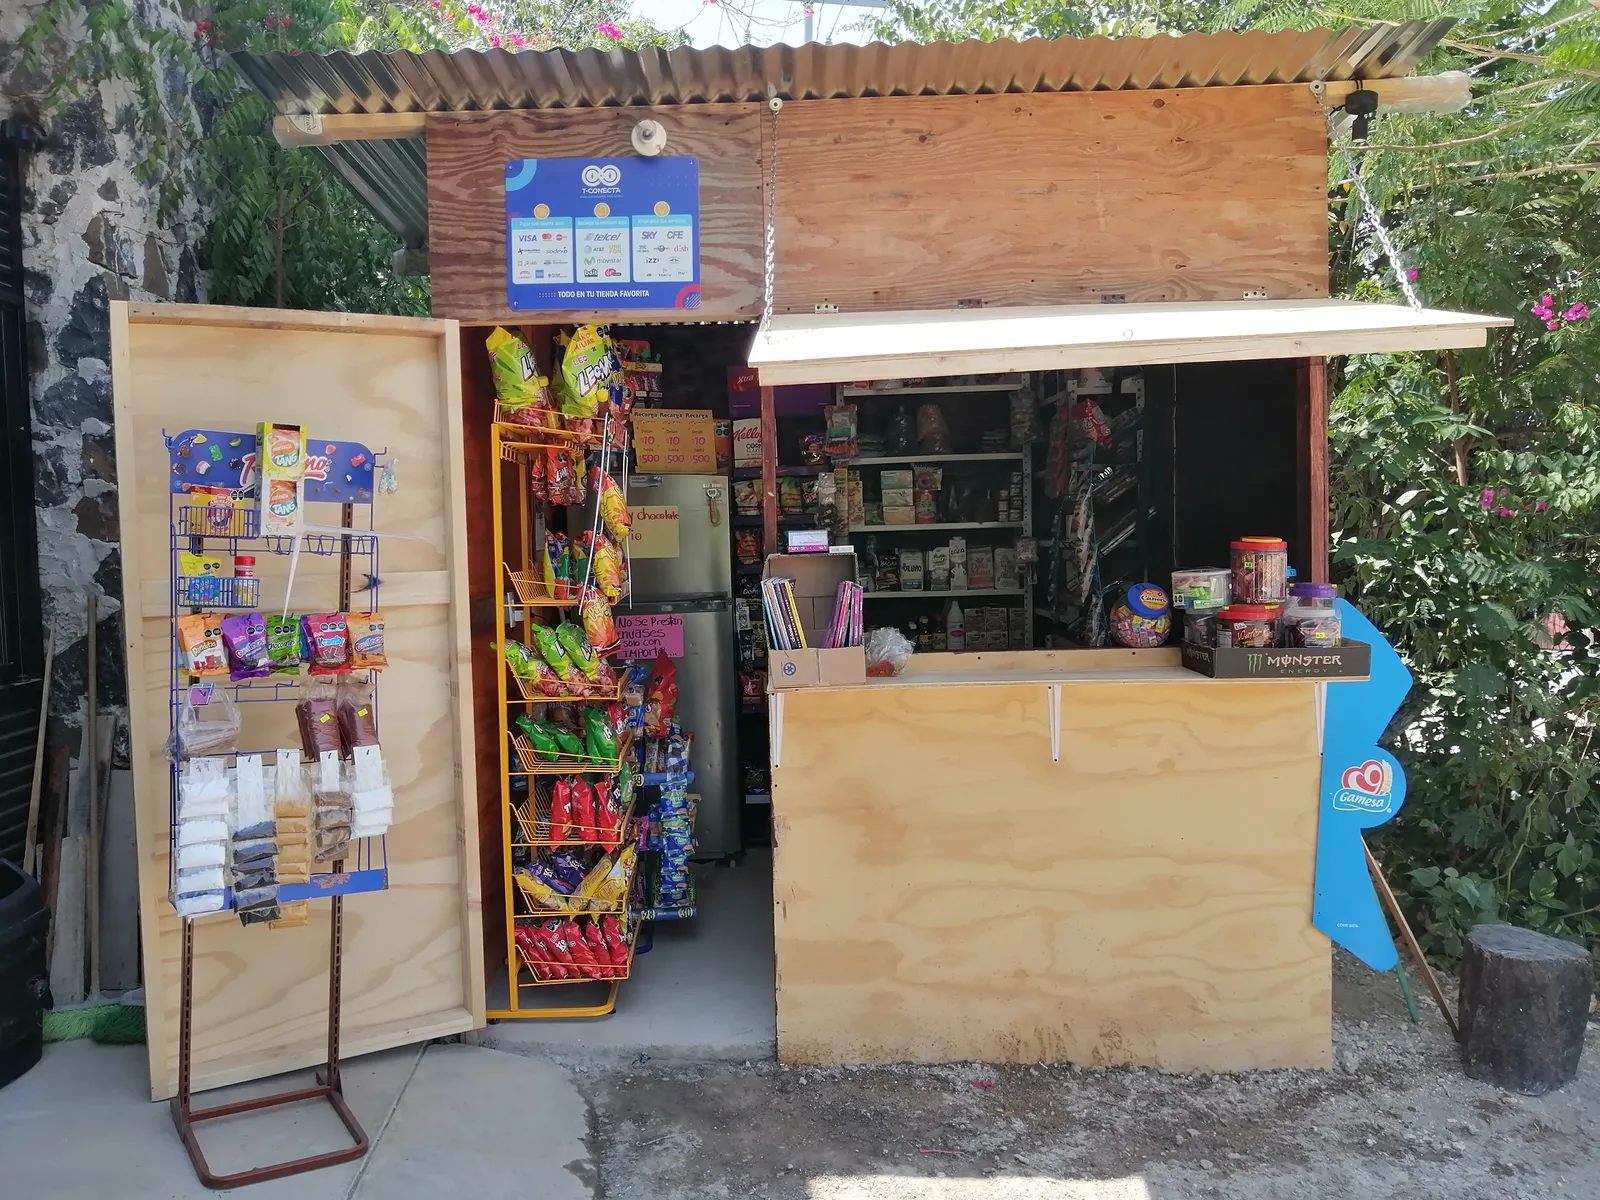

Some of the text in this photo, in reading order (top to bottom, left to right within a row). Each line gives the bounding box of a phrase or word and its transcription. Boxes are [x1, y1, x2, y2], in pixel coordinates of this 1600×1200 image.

[518, 234, 538, 242] VISA
[594, 232, 622, 241] telcel
[642, 231, 658, 240] SKY
[666, 230, 684, 240] CFE
[586, 290, 594, 298] TU
[734, 426, 762, 442] Kello
[275, 452, 298, 466] TANG
[272, 501, 296, 514] TANG
[637, 508, 680, 520] chocolate
[618, 618, 632, 628] No
[1268, 654, 1342, 667] MONSTER
[1340, 792, 1384, 808] Gamesa
